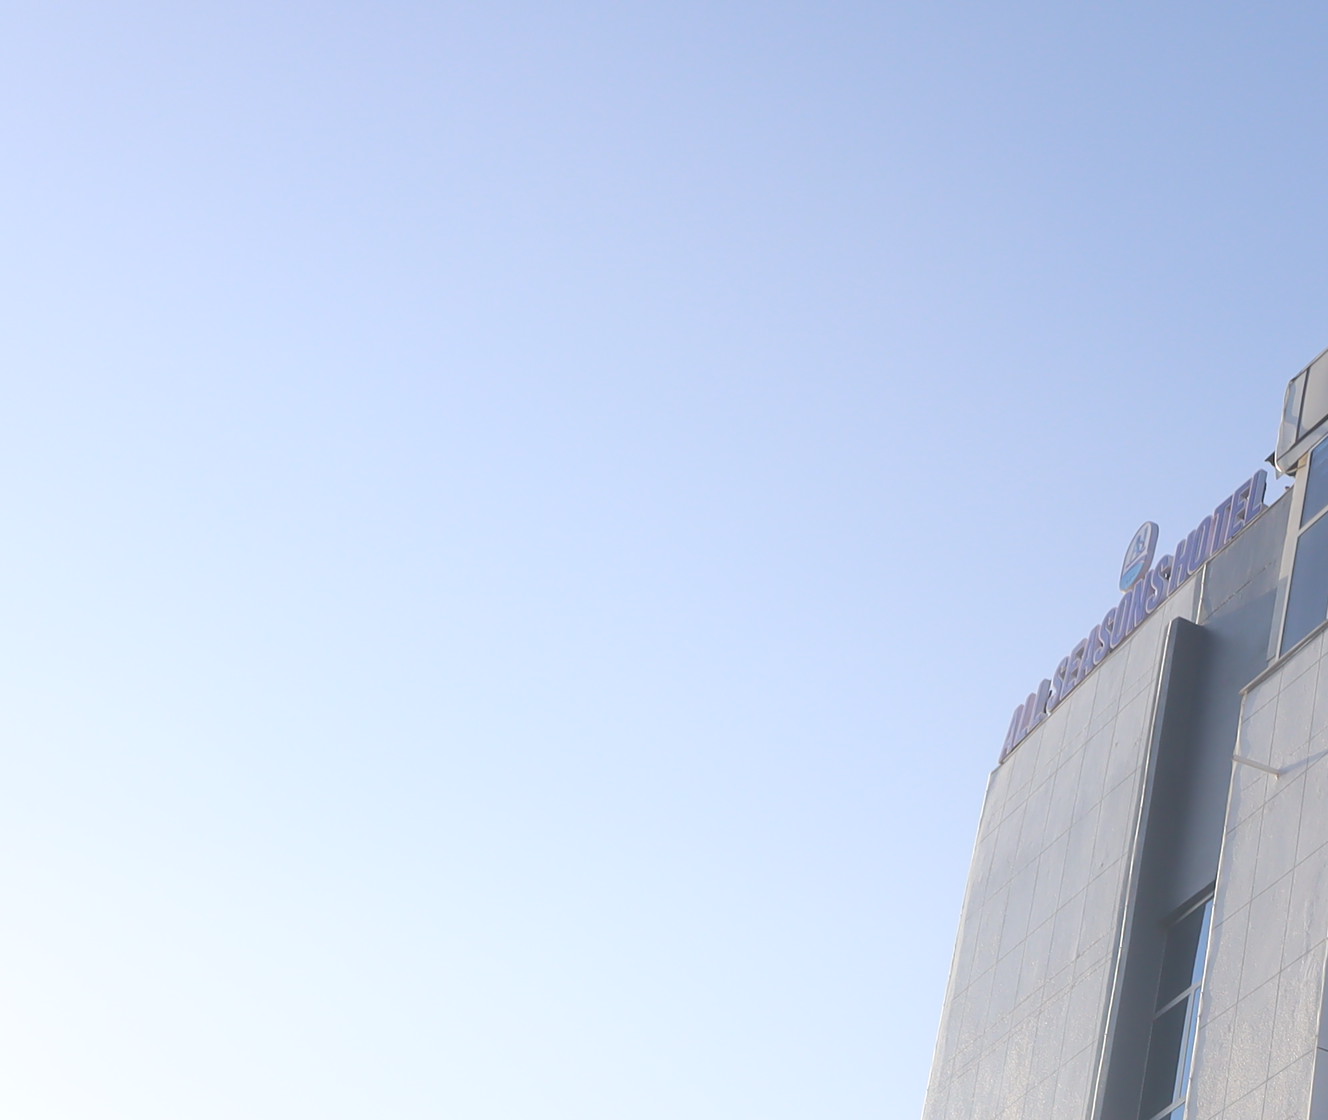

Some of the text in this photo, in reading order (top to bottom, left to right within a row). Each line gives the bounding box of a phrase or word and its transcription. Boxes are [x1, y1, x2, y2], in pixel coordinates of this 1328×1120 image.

[999, 469, 1267, 763] ALL SEASONS HOTEL
